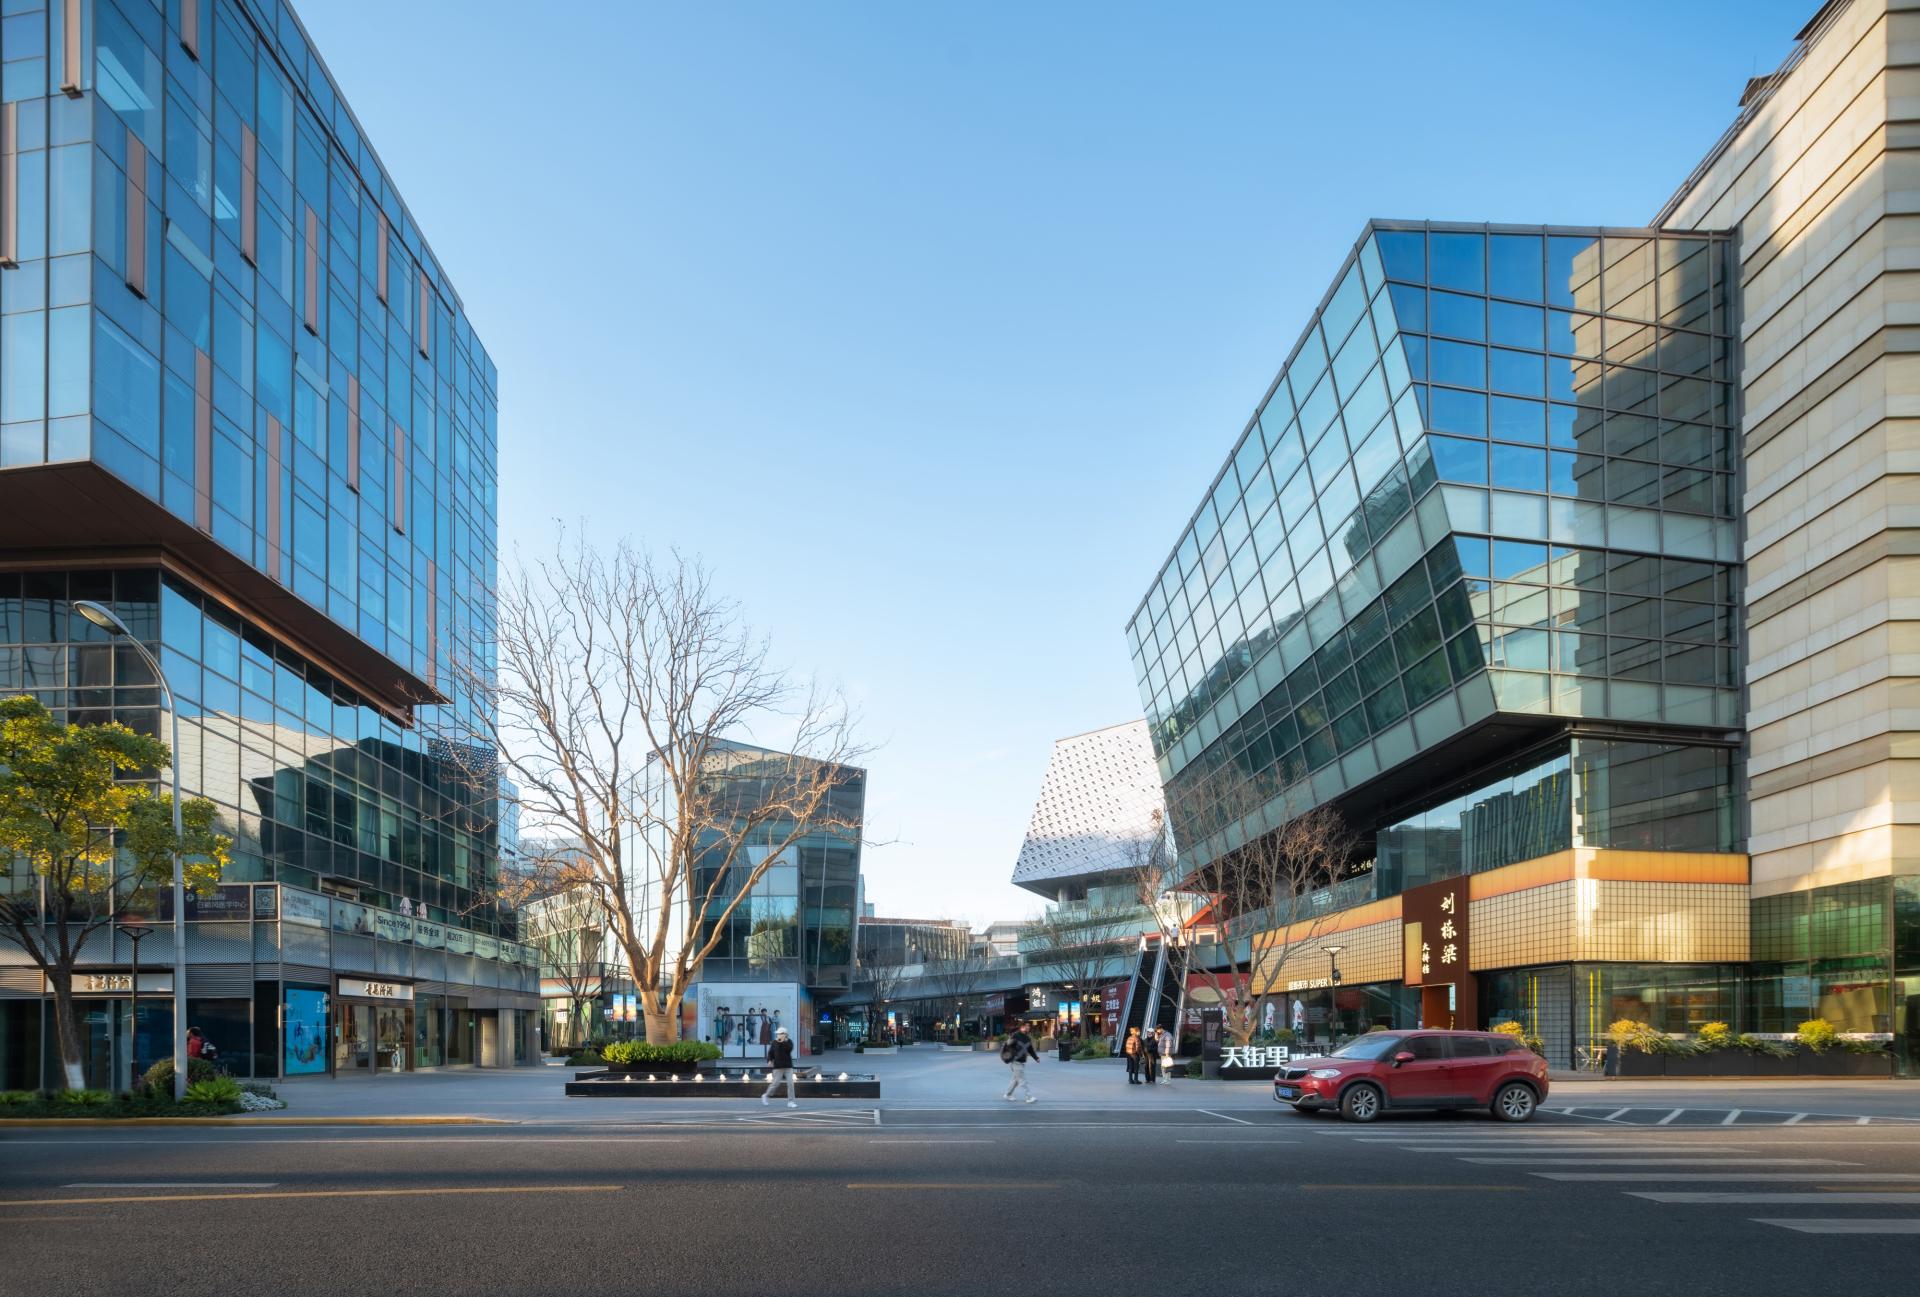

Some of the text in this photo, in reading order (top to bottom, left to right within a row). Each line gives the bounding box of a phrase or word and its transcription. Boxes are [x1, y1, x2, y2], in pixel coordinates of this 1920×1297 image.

[1309, 978, 1329, 989] SUPER
[1220, 1045, 1288, 1068] 天街里
